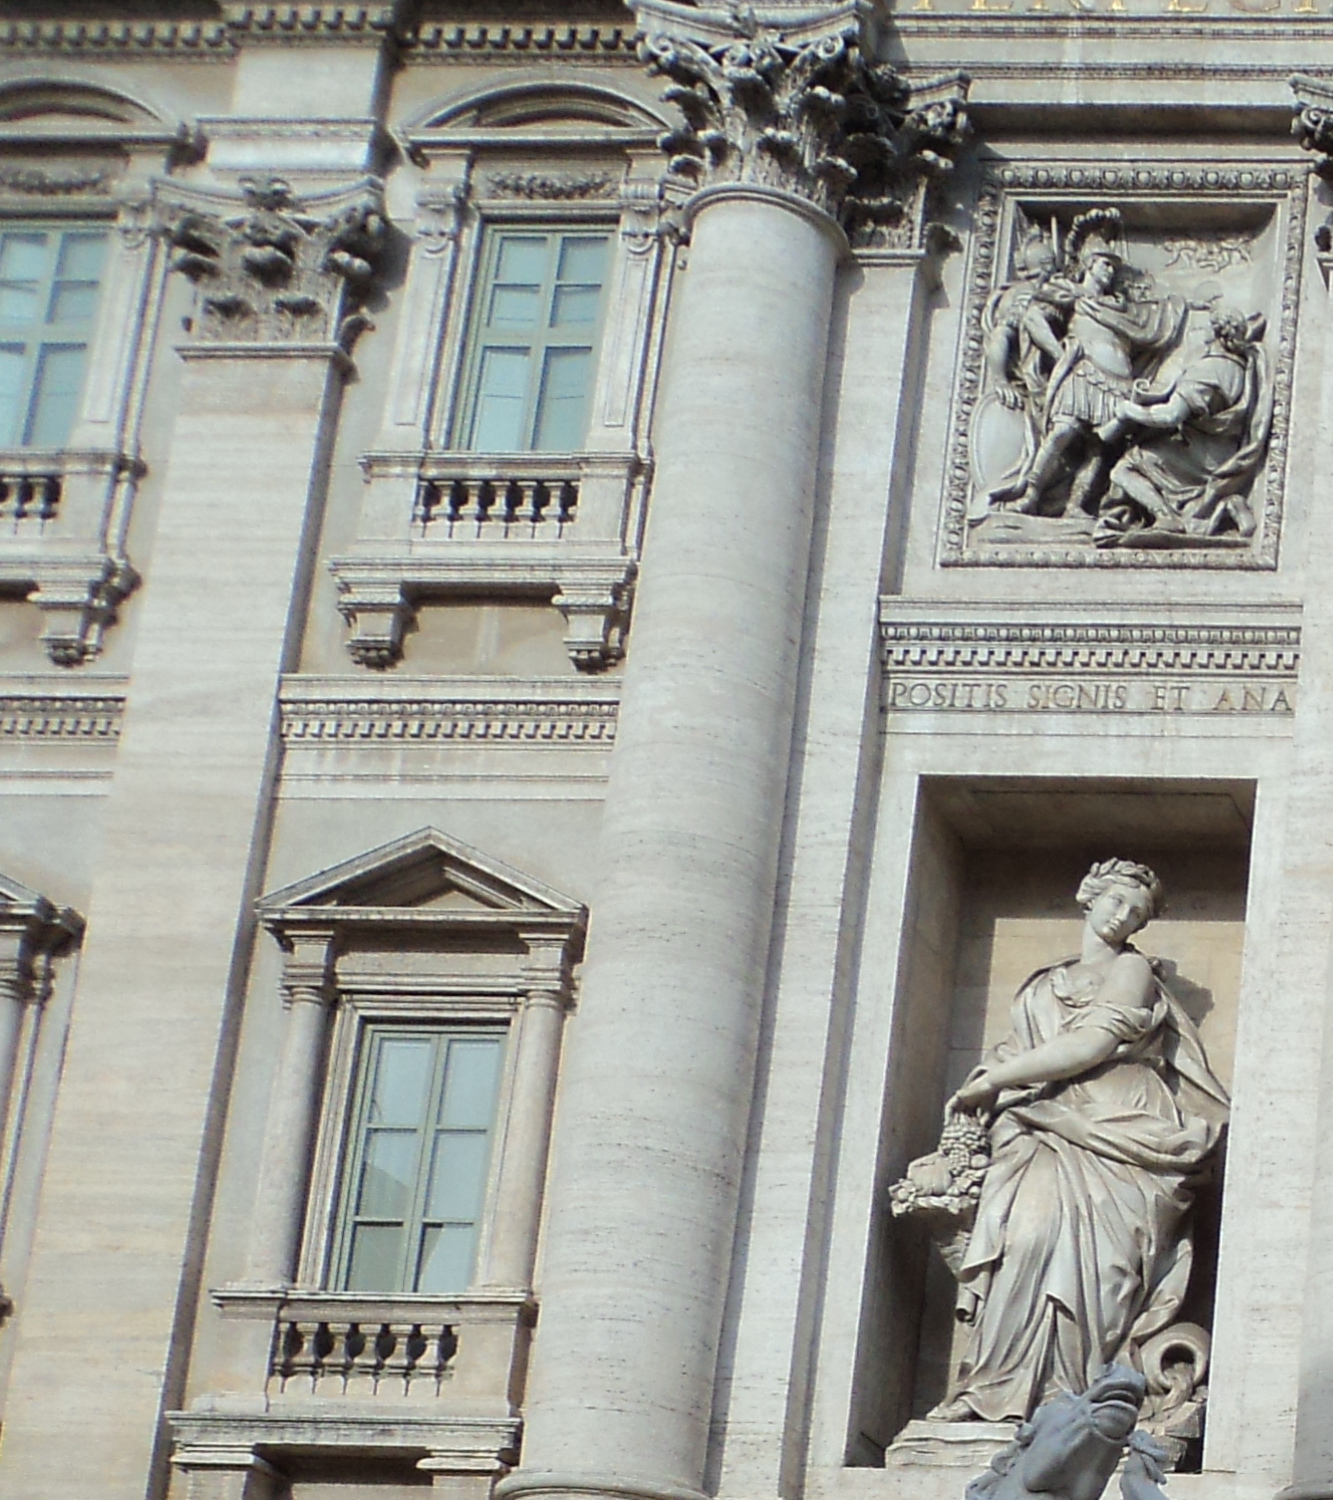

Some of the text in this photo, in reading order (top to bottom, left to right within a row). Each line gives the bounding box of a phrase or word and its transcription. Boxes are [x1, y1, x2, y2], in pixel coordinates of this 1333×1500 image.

[890, 682, 1293, 712] POSITIS SIGNIS ET ANA
